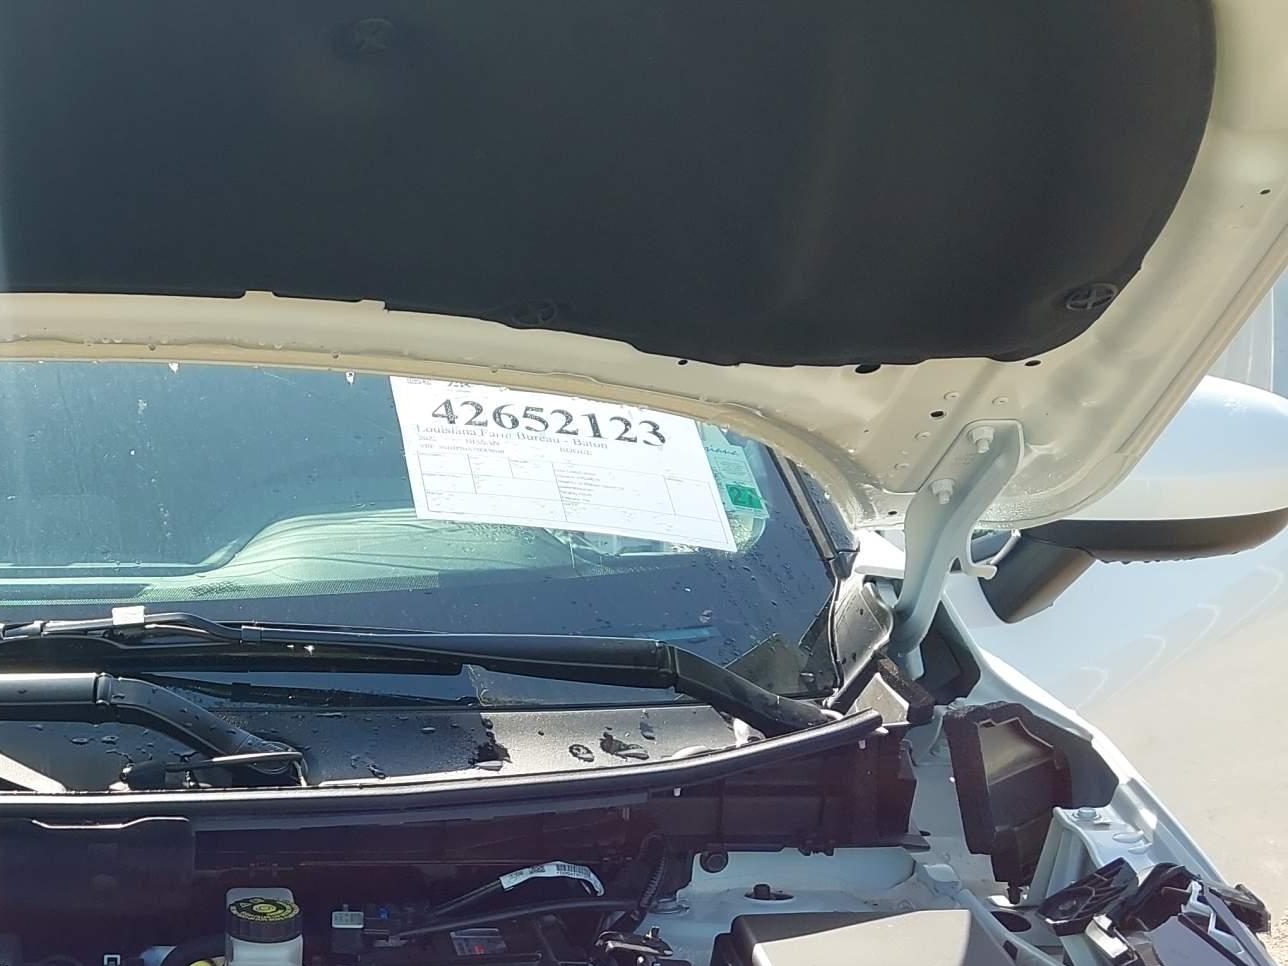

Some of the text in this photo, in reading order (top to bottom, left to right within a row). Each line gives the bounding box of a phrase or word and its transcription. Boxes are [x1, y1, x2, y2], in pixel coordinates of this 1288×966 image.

[431, 398, 667, 447] 42652123
[516, 431, 560, 444] Bureau
[572, 437, 608, 450] Baton
